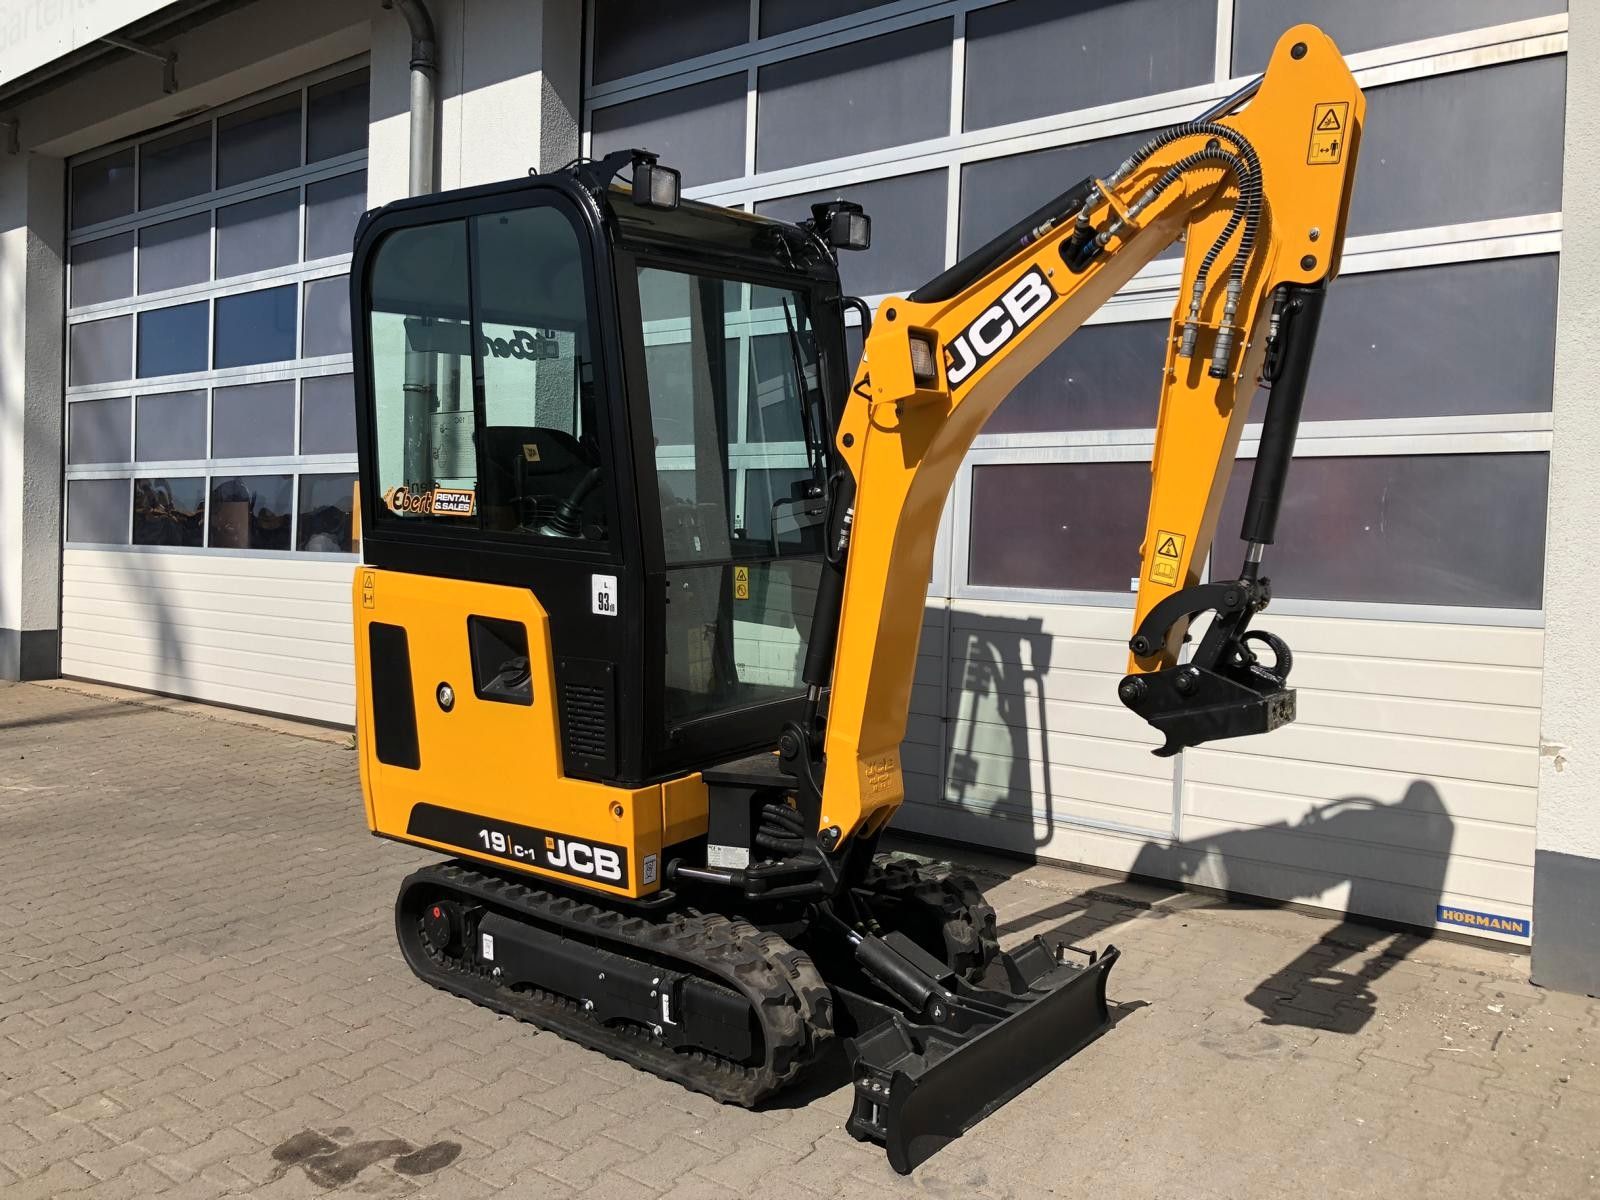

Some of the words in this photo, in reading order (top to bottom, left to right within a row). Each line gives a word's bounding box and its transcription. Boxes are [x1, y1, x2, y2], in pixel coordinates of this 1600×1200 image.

[947, 272, 1052, 384] JCB
[392, 486, 432, 513] Ebert
[434, 502, 442, 510] &
[442, 502, 470, 511] SALES
[436, 493, 471, 502] RENTAL
[479, 829, 506, 852] 19
[547, 839, 622, 881] JCB
